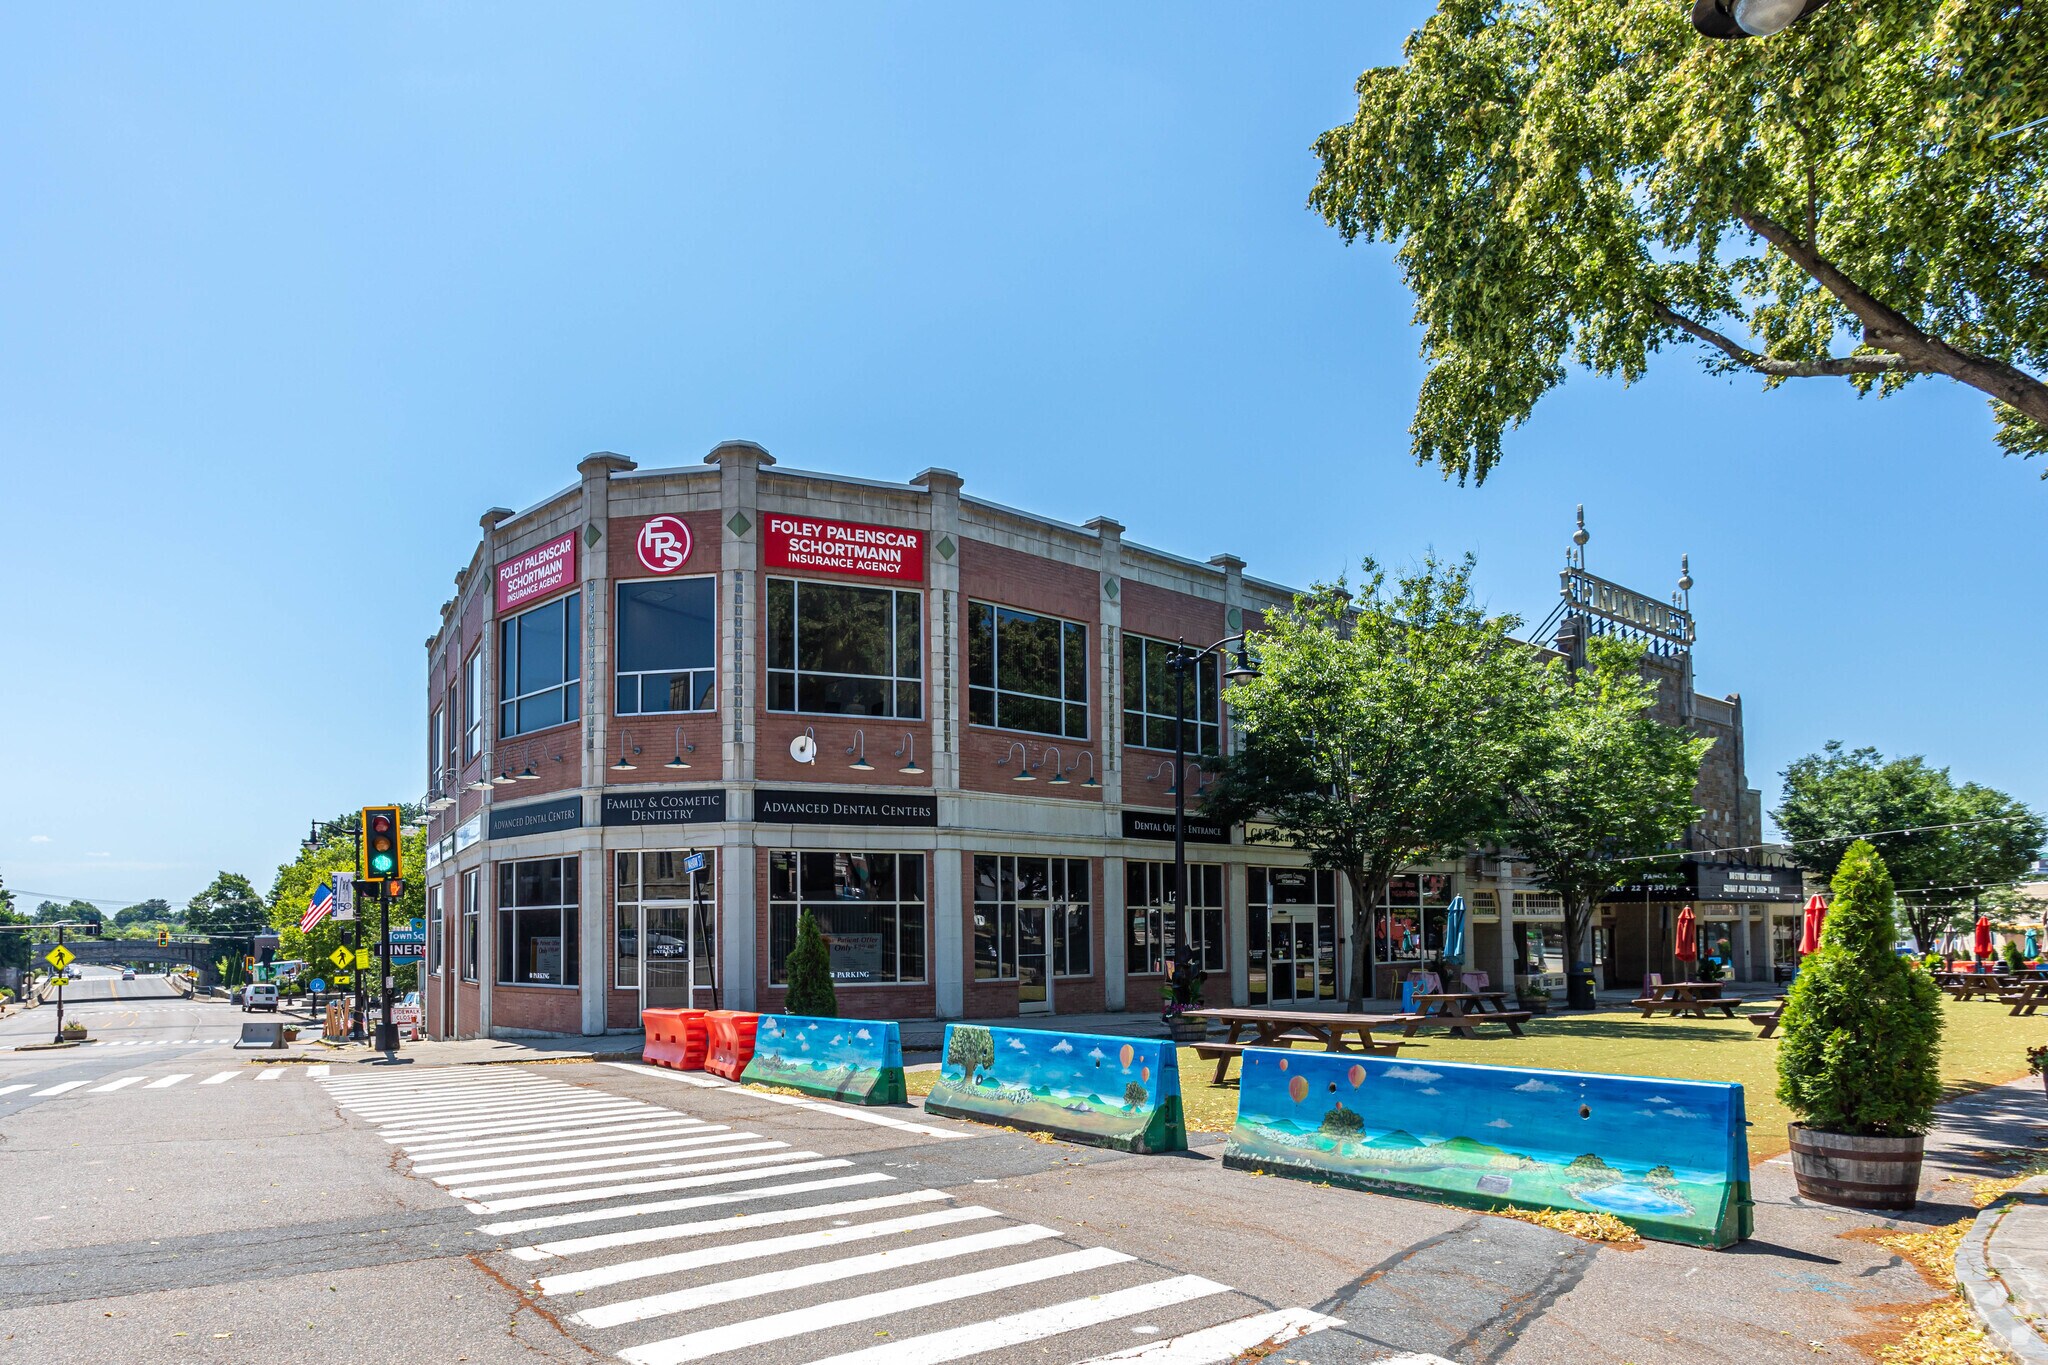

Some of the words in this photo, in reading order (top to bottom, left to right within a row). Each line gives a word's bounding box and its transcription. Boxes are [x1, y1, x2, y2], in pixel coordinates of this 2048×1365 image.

[645, 521, 683, 567] FPS
[771, 520, 822, 537] FOLEY
[827, 525, 917, 548] PALENSCAR
[500, 561, 525, 581] FOLEY
[525, 539, 571, 570] PALENSCAR
[789, 538, 901, 562] SCHORTMANN
[788, 553, 853, 568] INSURANCE
[856, 561, 902, 574] AGENCY
[507, 559, 563, 592] SCHORTMANN
[507, 583, 538, 603] INSURANCE
[539, 573, 563, 590] AGENCY
[606, 798, 645, 809] FAMILY
[648, 797, 658, 808] &
[659, 795, 720, 807] COSMETIC
[763, 801, 829, 814] ADVANCED
[833, 803, 878, 816] DENTAL
[881, 804, 931, 817] CENTERS
[493, 815, 524, 830] ADVANCED
[524, 813, 547, 826] DENTAL
[548, 808, 576, 823] CENTERS
[631, 809, 694, 821] DENTISTRY
[1134, 820, 1162, 832] DENTAL
[1163, 822, 1187, 834] OFFE
[1188, 824, 1222, 836] ENTRANCE
[337, 902, 352, 912] 150
[389, 931, 412, 942] Town
[379, 944, 423, 955] INER
